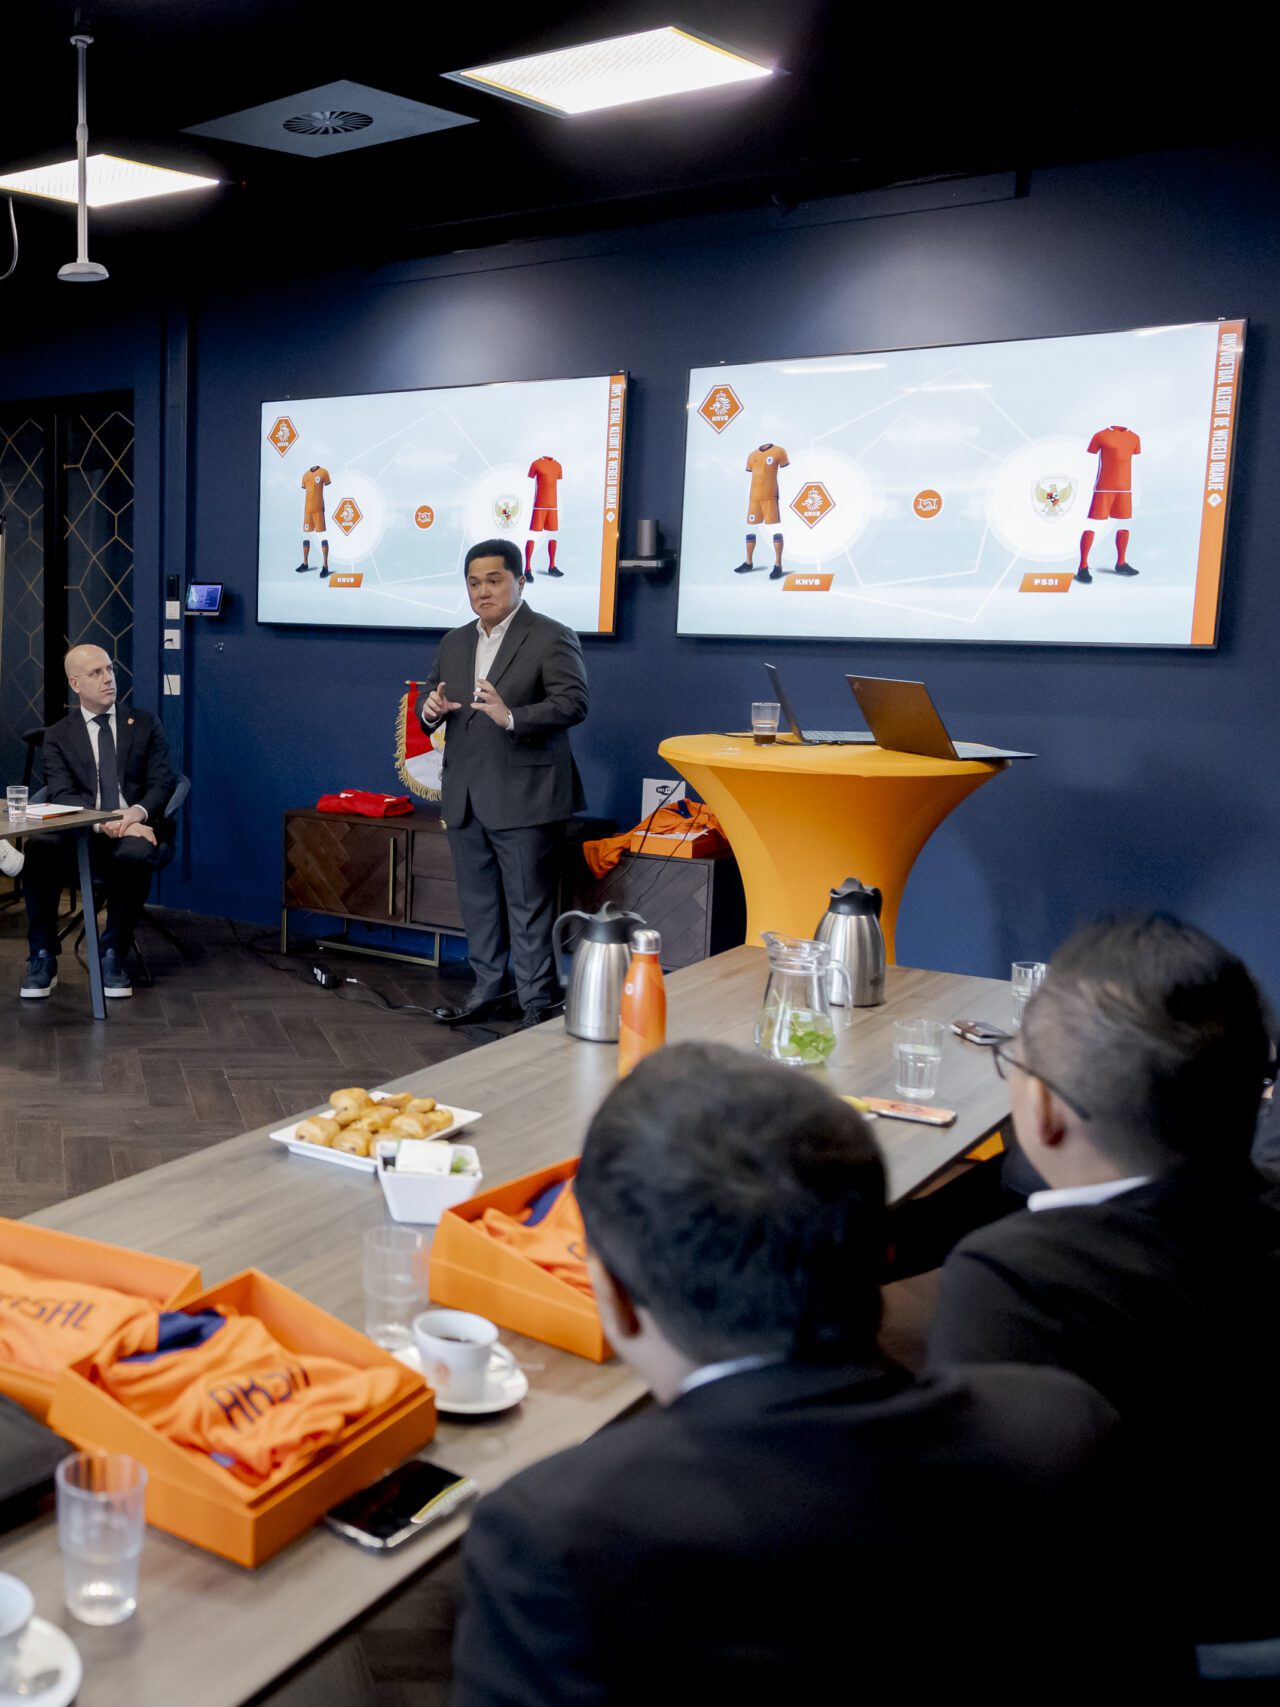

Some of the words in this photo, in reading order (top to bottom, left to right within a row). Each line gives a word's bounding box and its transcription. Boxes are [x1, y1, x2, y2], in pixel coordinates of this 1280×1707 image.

[1218, 350, 1235, 384] VOETBAL
[1215, 386, 1232, 414] KLEURT
[1214, 417, 1229, 427] DE
[1211, 428, 1228, 460] WERELD
[1208, 461, 1225, 491] ORANJE
[795, 578, 821, 586] KNVB
[1033, 578, 1059, 586] PSSI
